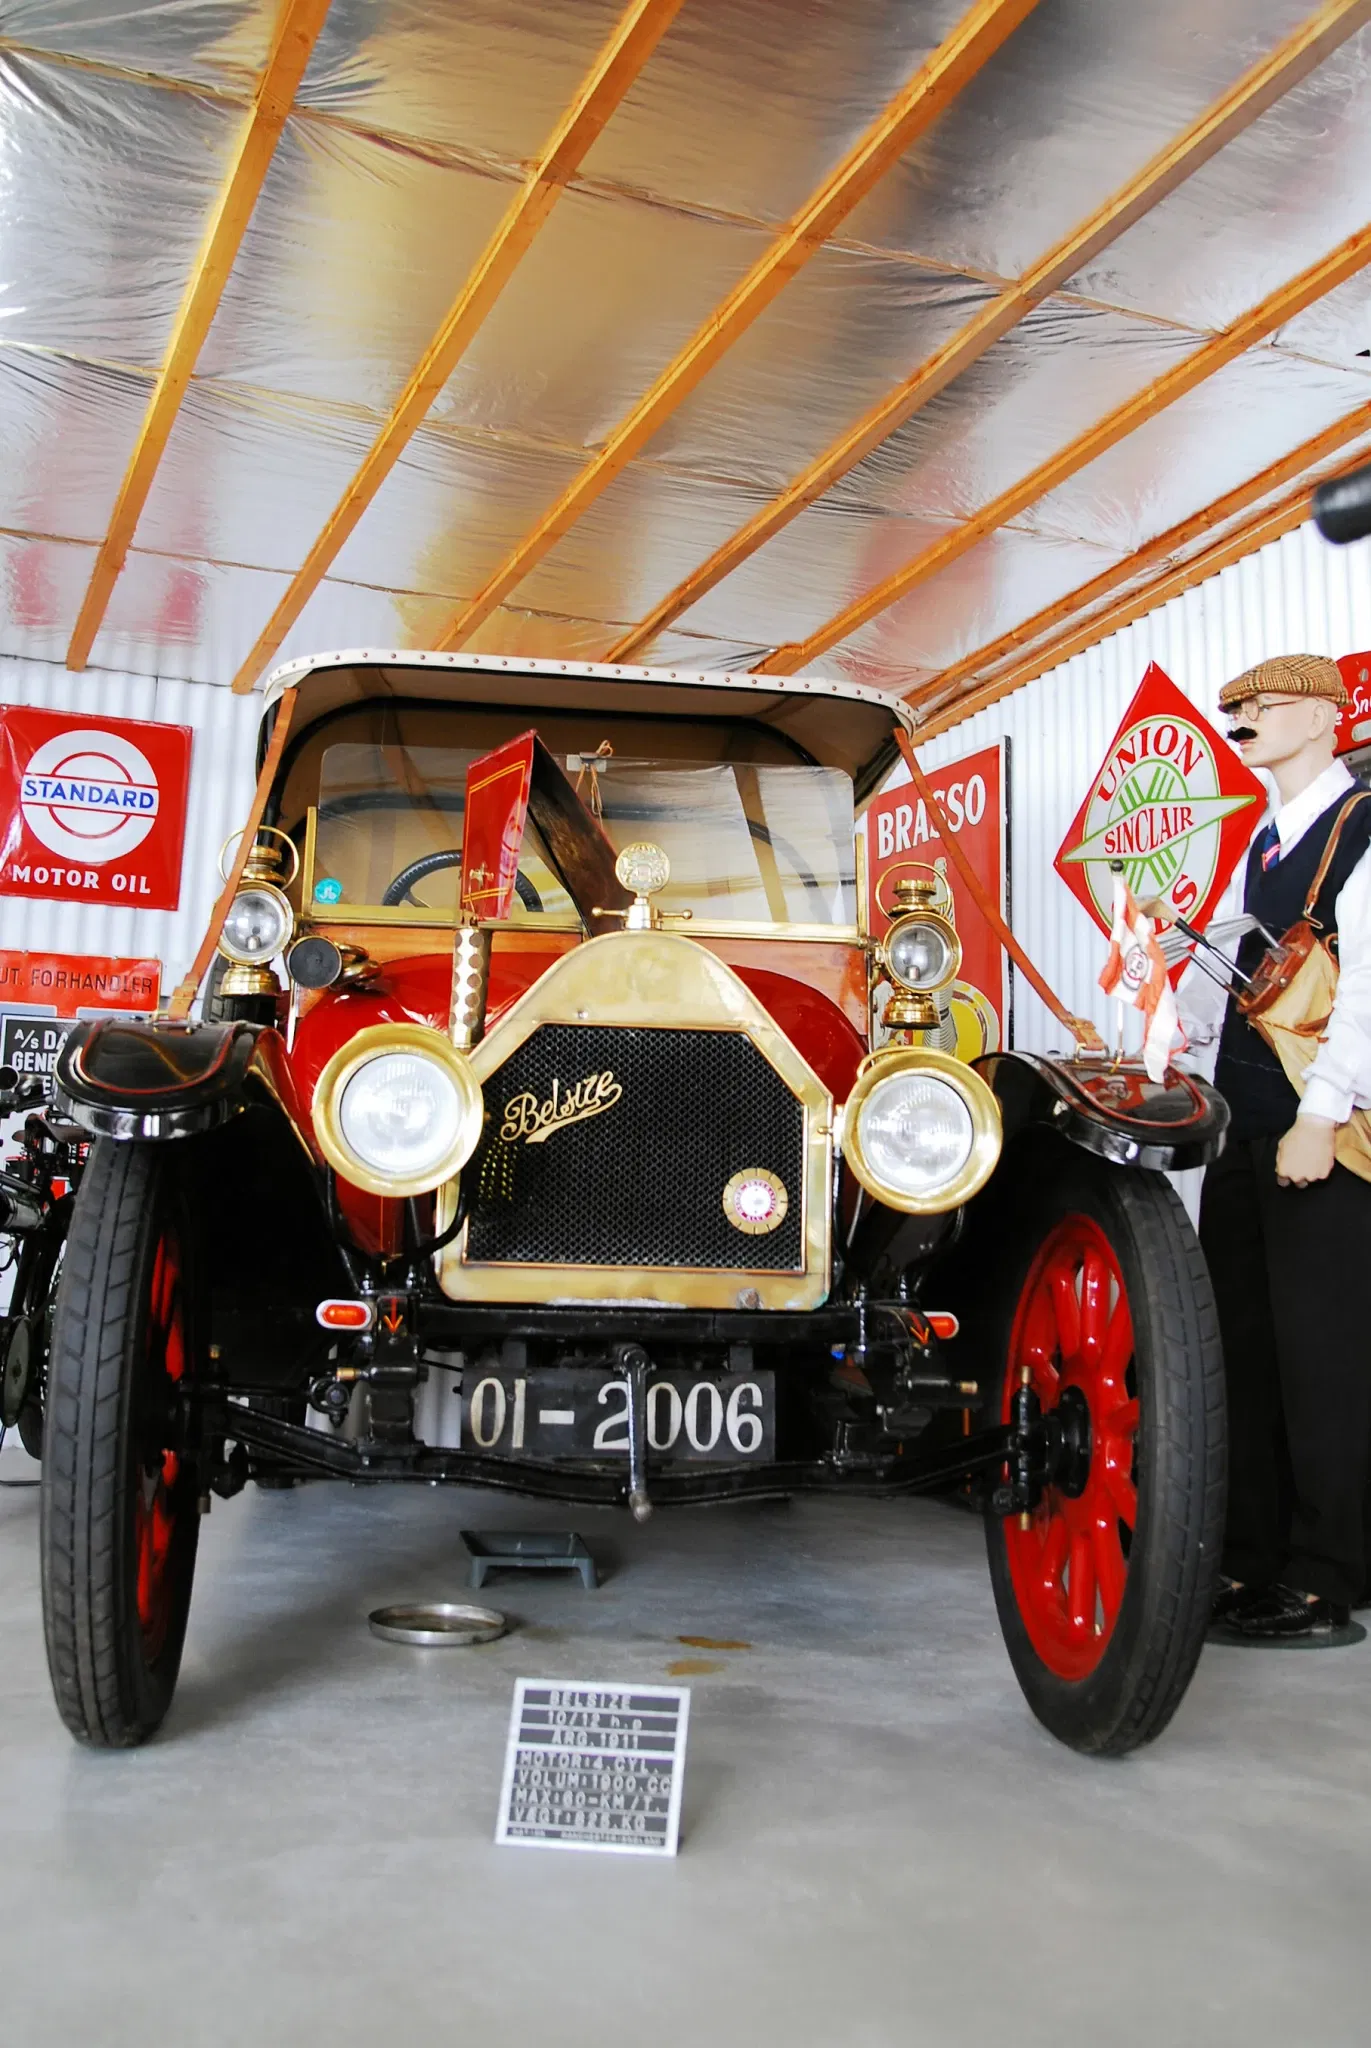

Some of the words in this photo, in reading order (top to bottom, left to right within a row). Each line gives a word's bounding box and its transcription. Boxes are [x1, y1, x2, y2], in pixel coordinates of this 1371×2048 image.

[1097, 724, 1204, 802] UNION
[24, 780, 154, 809] STANDARD
[1104, 806, 1194, 854] SINCLAIR
[12, 863, 100, 889] MOTOR
[111, 873, 151, 894] OIL
[31, 969, 153, 994] FORHANDLER
[500, 1070, 622, 1142] Belsize
[550, 1691, 632, 1710] BELSIZE
[548, 1710, 600, 1728] 10/12
